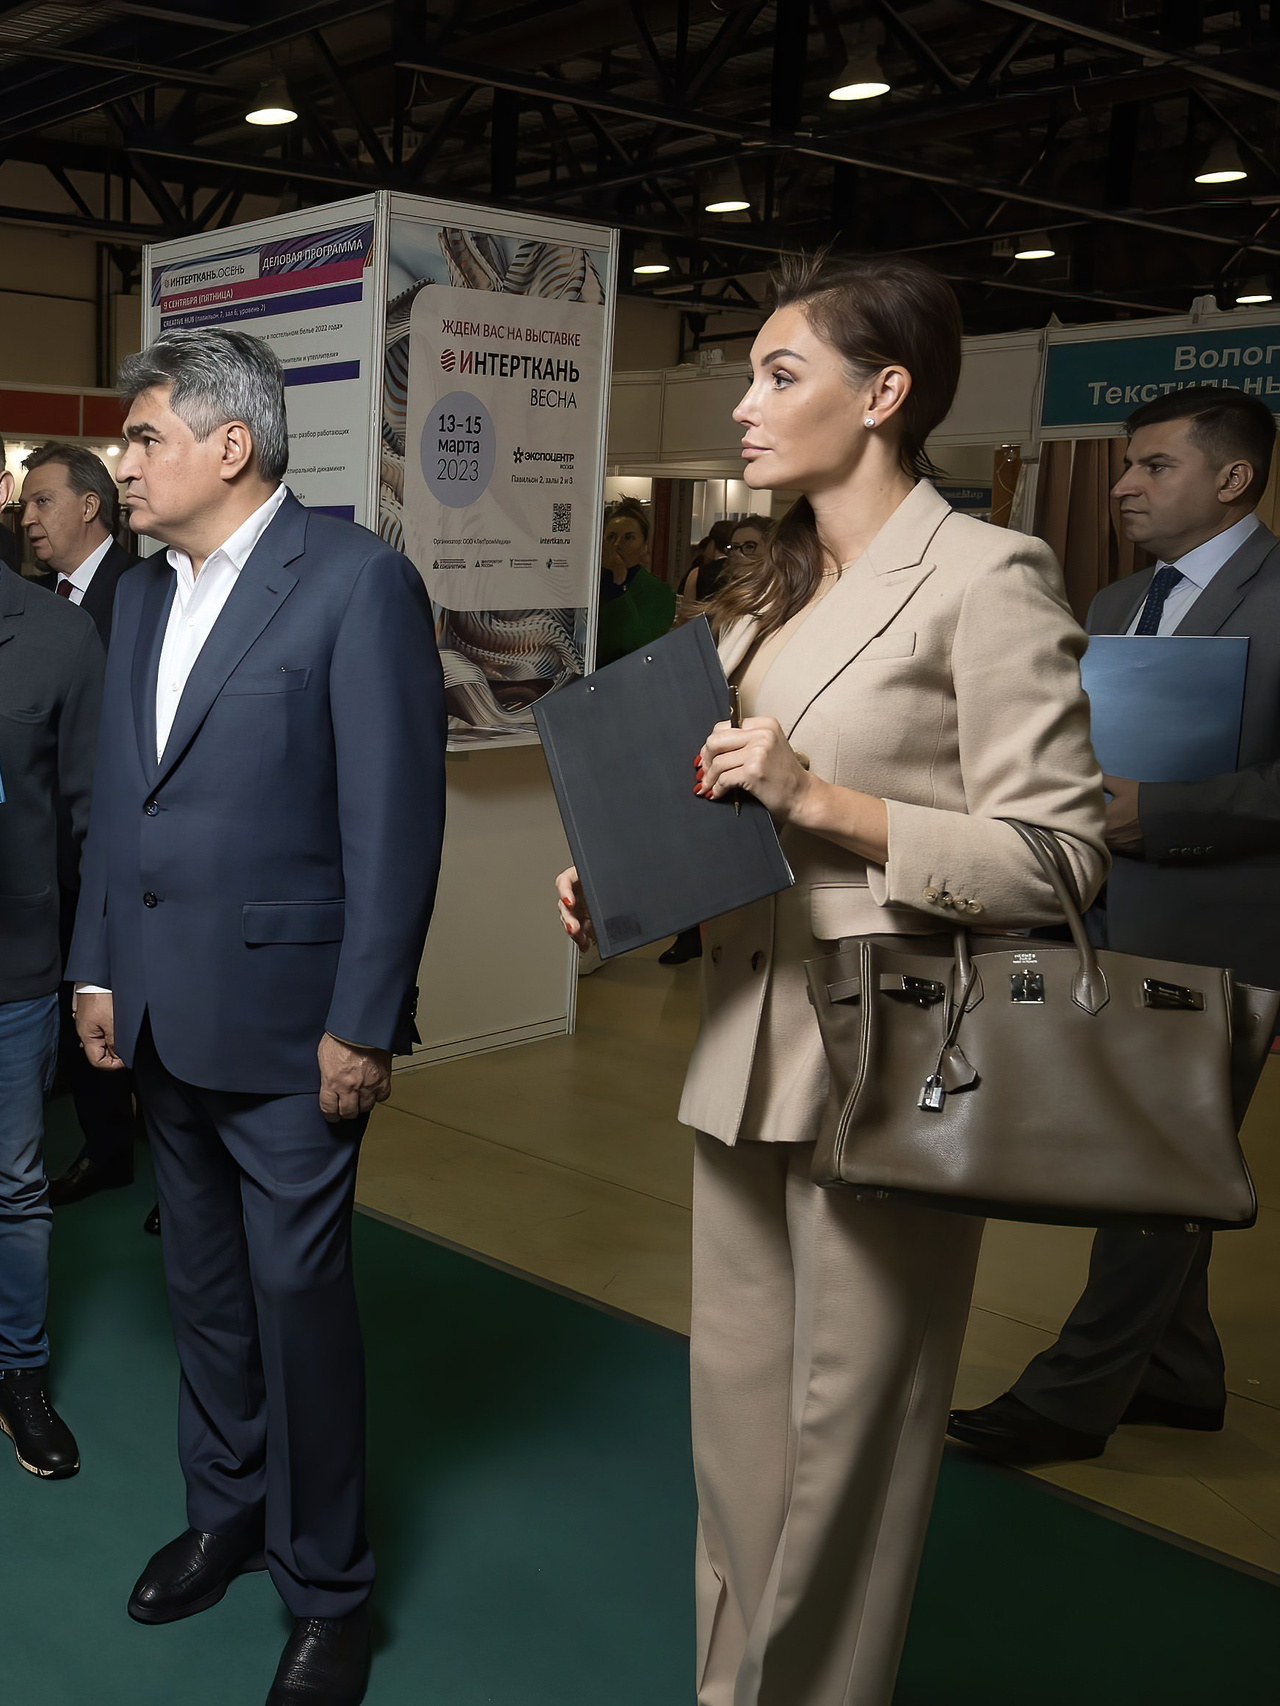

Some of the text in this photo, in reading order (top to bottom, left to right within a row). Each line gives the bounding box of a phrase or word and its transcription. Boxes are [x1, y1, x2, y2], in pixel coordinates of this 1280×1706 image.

[262, 239, 363, 271] ДЕЛОВАЯ ПРОГРАММА
[168, 296, 200, 309] СЕНТЯБРЯ
[199, 288, 234, 304] (ПЯТНИЦА)
[315, 324, 328, 333] 2022
[441, 319, 581, 347] ЖДЕМ ВАС НА ВЫСТАВКЕ
[460, 350, 580, 383] ИНТЕРТКАНЬ
[530, 388, 577, 409] ВЕСНА
[299, 430, 316, 439] разбор
[317, 429, 349, 438] работающих
[438, 439, 480, 456] марта
[524, 451, 575, 463] ЭКСПОЦЕНТР
[286, 466, 317, 474] спиральной
[437, 458, 479, 481] 2023
[511, 474, 539, 483] Павильон
[560, 476, 563, 484] 2
[569, 476, 573, 484] 3
[540, 537, 571, 545] intertkan.ru
